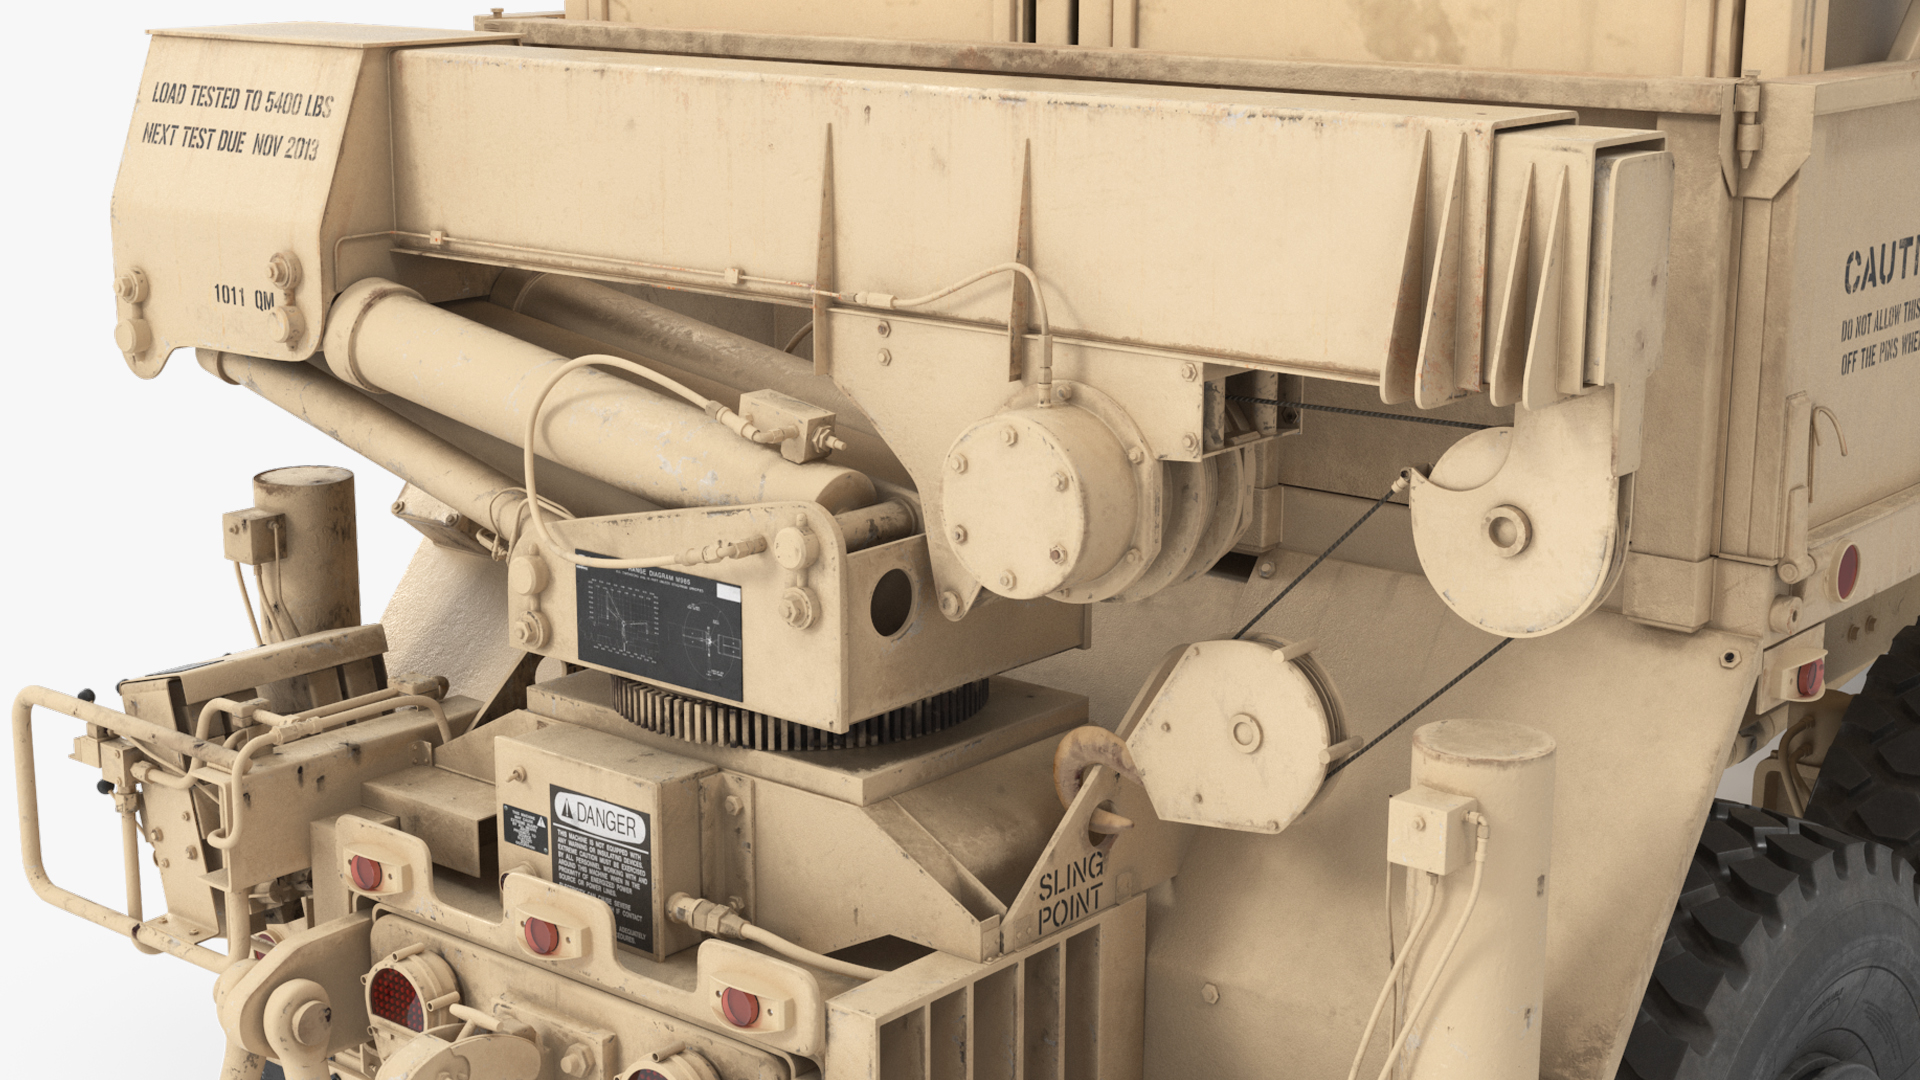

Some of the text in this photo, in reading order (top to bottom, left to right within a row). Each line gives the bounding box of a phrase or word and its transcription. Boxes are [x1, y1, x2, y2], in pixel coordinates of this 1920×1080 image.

[152, 82, 334, 118] LOAD TESTED TO 5400 LBS
[142, 122, 319, 161] NEXT TEST DUE NOV 2013
[215, 284, 274, 311] 1011 QM
[1841, 298, 1920, 342] DO NOT ALLOW THIS
[1841, 350, 1858, 375] OFF
[1861, 344, 1877, 370] THE
[1879, 337, 1898, 363] PINS
[649, 570, 674, 580] DIAGRAM
[577, 802, 636, 838] DANGER
[557, 836, 567, 844] ANY
[568, 840, 588, 851] WARNING
[597, 848, 622, 862] INSULATING
[558, 829, 567, 837] THIS
[569, 832, 587, 844] MACHINE
[606, 845, 628, 856] EQUIPPED
[630, 851, 642, 861] WITH
[558, 844, 577, 855] EXTREME
[579, 850, 598, 861] CAUTION
[599, 856, 611, 865] MUST
[622, 863, 646, 877] EXERCISED
[558, 858, 576, 869] AROUND
[578, 864, 588, 873] THIS
[589, 868, 608, 879] MACHINE
[610, 875, 623, 883] WHEN
[631, 881, 640, 890] THE
[603, 865, 623, 877] WORKING
[625, 873, 637, 881] WITH
[638, 877, 648, 885] AND
[558, 865, 581, 877] PROXIMITY
[591, 875, 615, 889] ENERGIZED
[616, 884, 632, 894] POWER
[559, 873, 576, 883] SOURCE
[586, 881, 602, 892] POWER
[1039, 851, 1103, 901] SLING
[614, 900, 631, 911] SEVERE
[622, 911, 643, 922] CONTACT
[1039, 882, 1103, 935] POINT
[617, 933, 636, 944] EDURES.
[619, 926, 646, 940] ADEQUATELY
